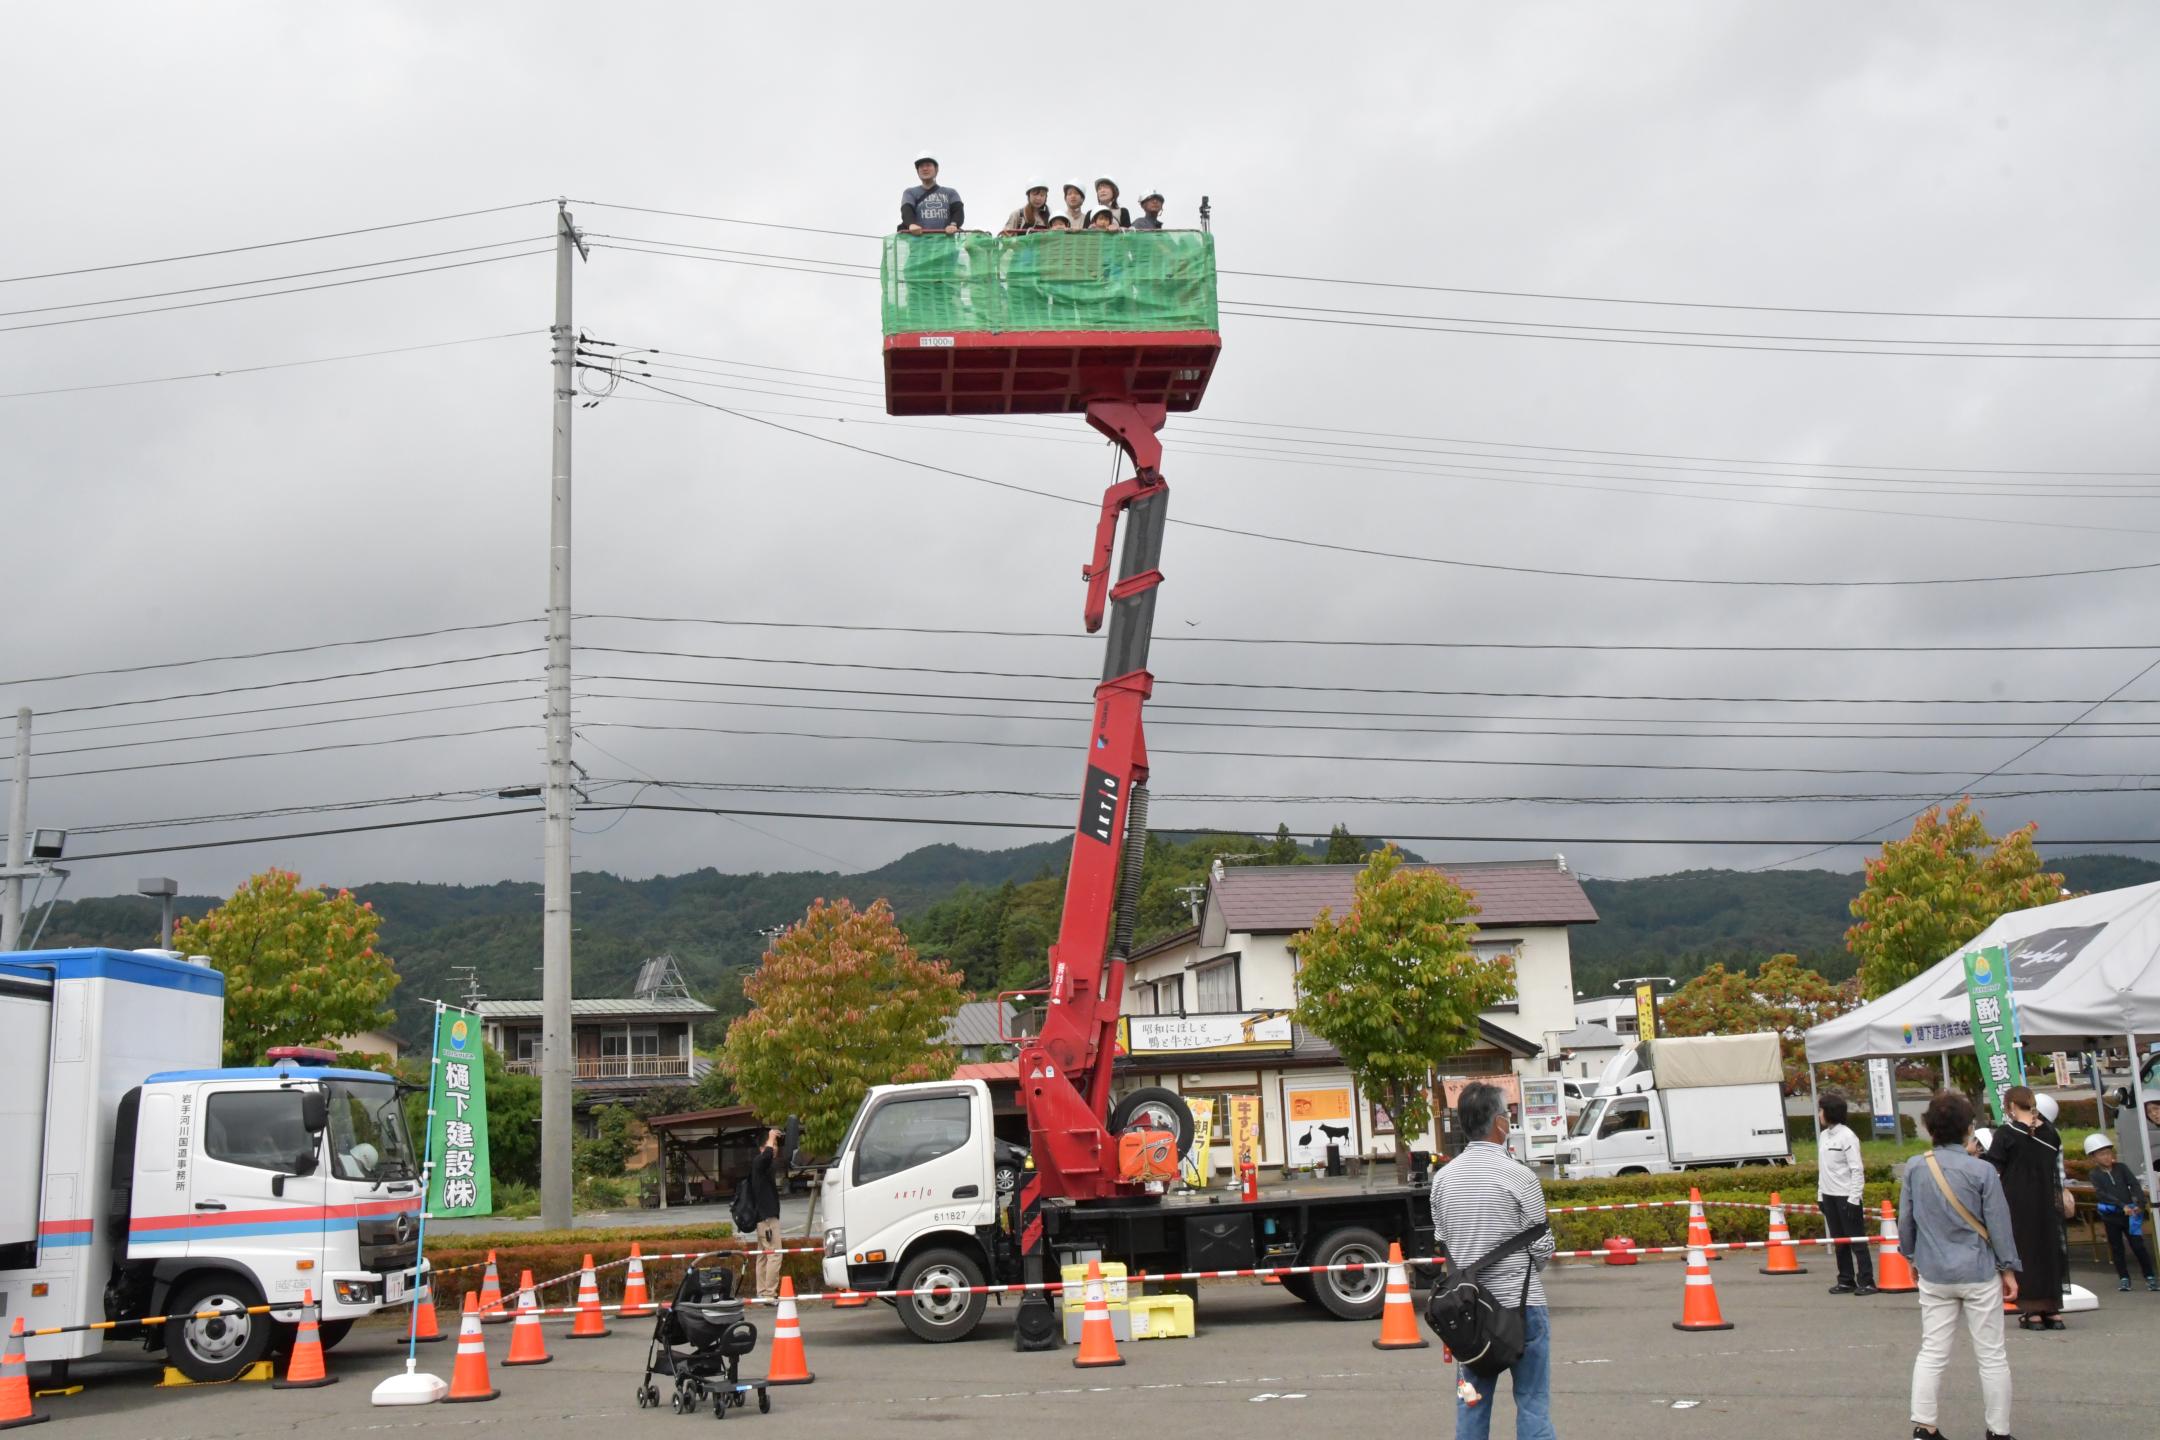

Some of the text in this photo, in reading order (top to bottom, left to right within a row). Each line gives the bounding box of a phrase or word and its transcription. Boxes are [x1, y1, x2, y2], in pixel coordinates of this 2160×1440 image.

[1916, 1020, 1971, 1041] 樋下建設株式会
[175, 1094, 193, 1192] 岩手河川国道事務所
[934, 1211, 966, 1221] 611827
